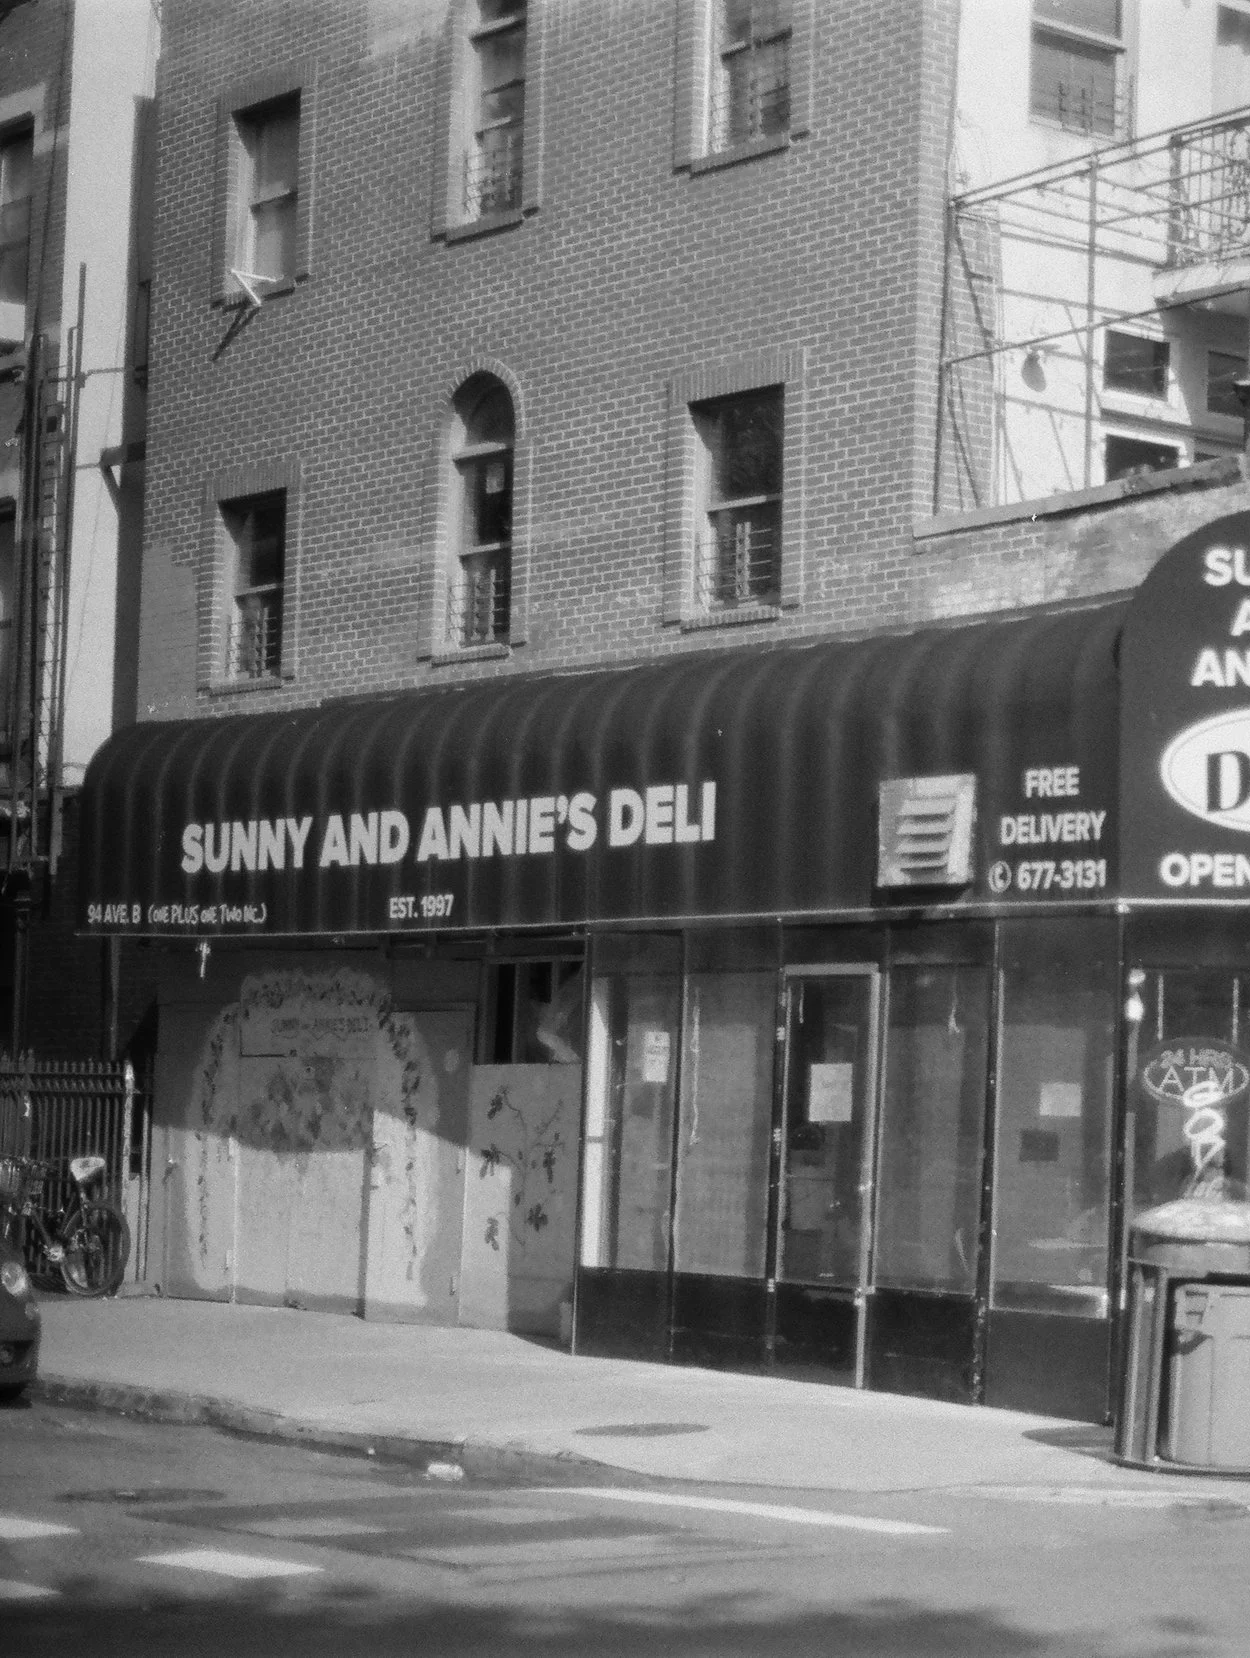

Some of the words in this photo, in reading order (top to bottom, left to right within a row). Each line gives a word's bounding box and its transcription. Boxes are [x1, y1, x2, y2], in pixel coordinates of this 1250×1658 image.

[1025, 767, 1079, 797] FREE
[182, 817, 312, 873] SUNNY
[319, 810, 409, 867] AND
[417, 792, 597, 861] ANNIE'S
[609, 782, 716, 846] DELI
[1001, 811, 1105, 845] DELIVERY
[1017, 860, 1106, 889] 677-3131
[88, 904, 102, 923] 94
[132, 904, 140, 923] B
[171, 905, 199, 925] PLUS
[390, 897, 418, 919] EST.
[421, 894, 453, 917] 1997
[1159, 1065, 1235, 1095] ATM
